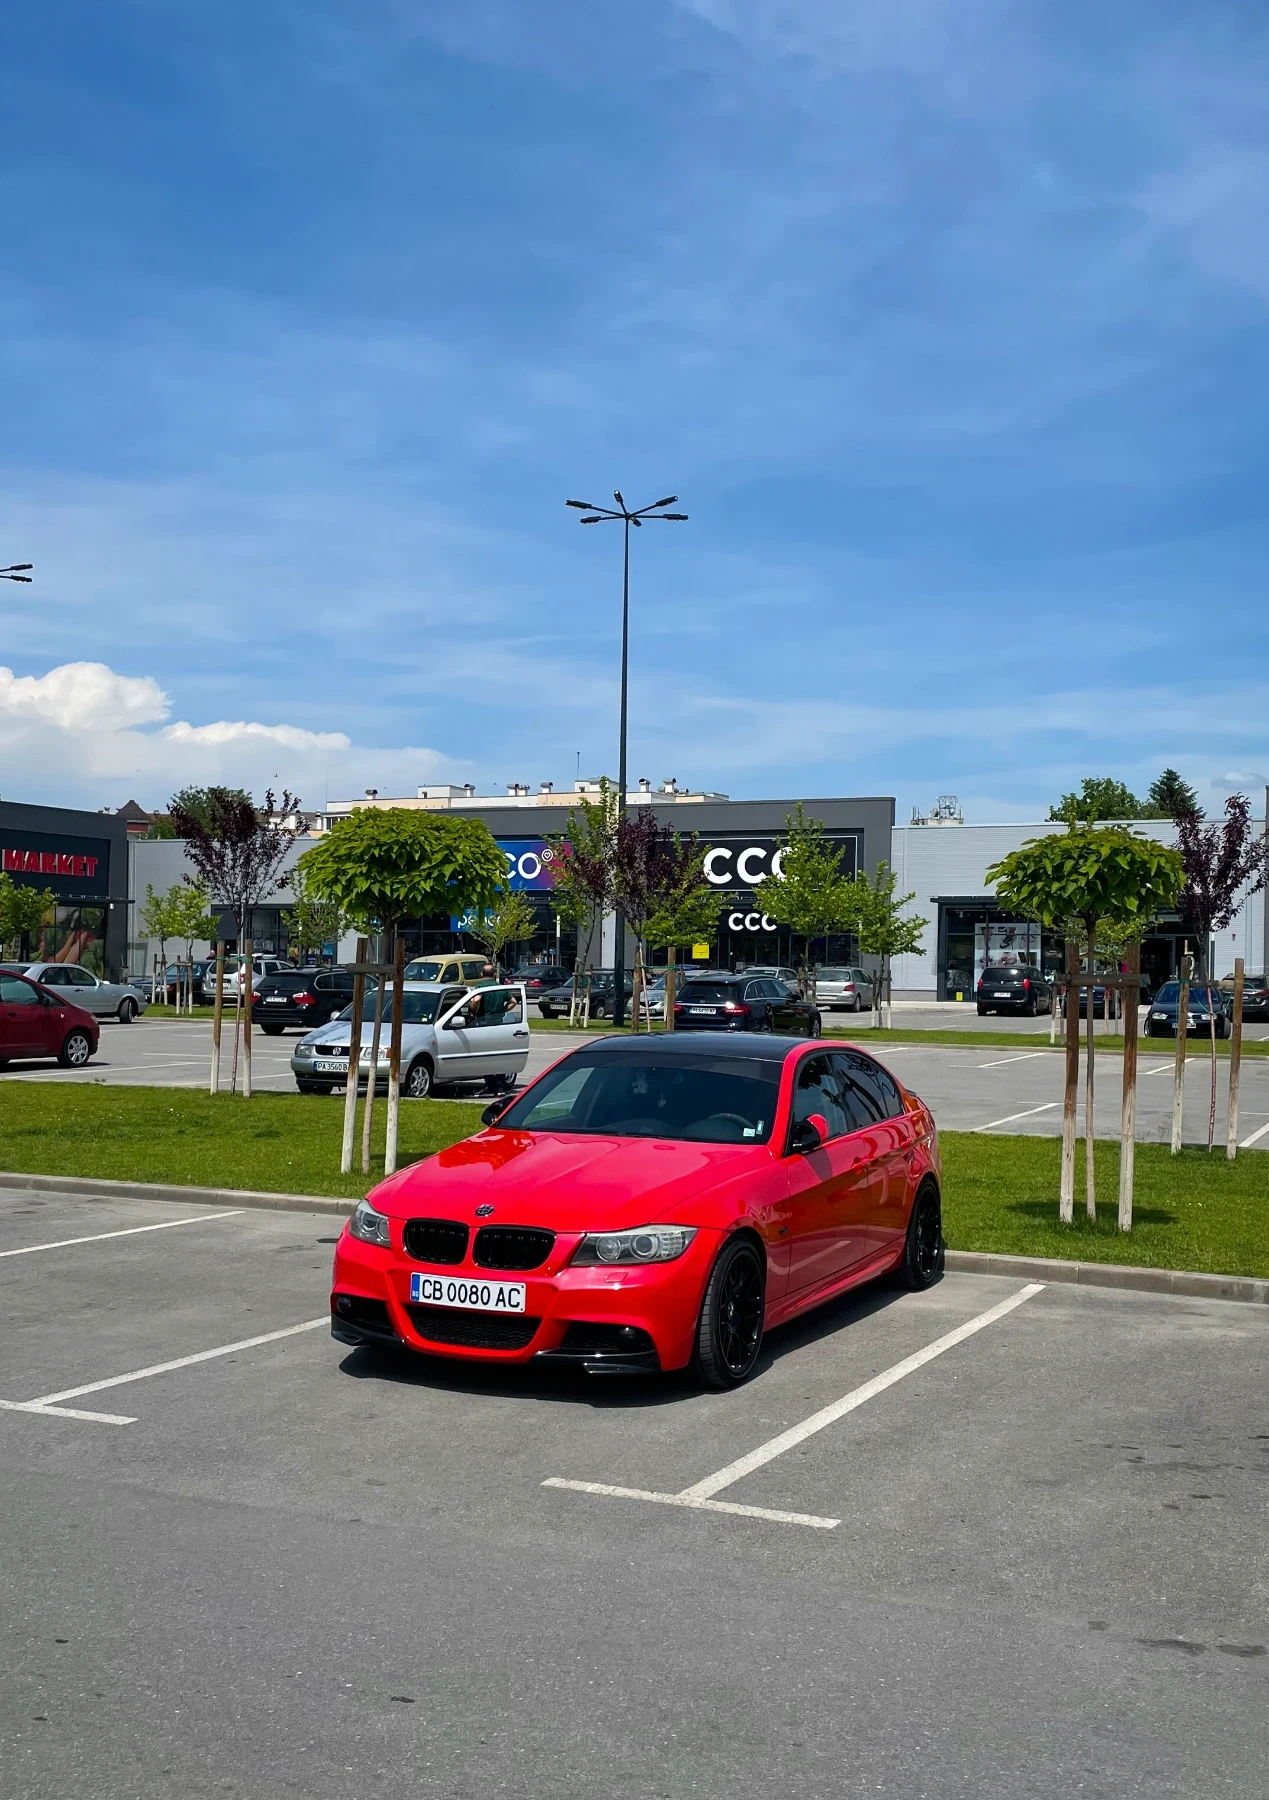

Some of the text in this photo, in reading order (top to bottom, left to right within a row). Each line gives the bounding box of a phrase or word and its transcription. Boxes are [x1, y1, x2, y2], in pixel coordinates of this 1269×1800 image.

[2, 849, 98, 877] MARKET
[703, 847, 799, 884] CCC
[728, 912, 777, 931] CCC
[422, 1279, 521, 1308] CB 0080 AC
